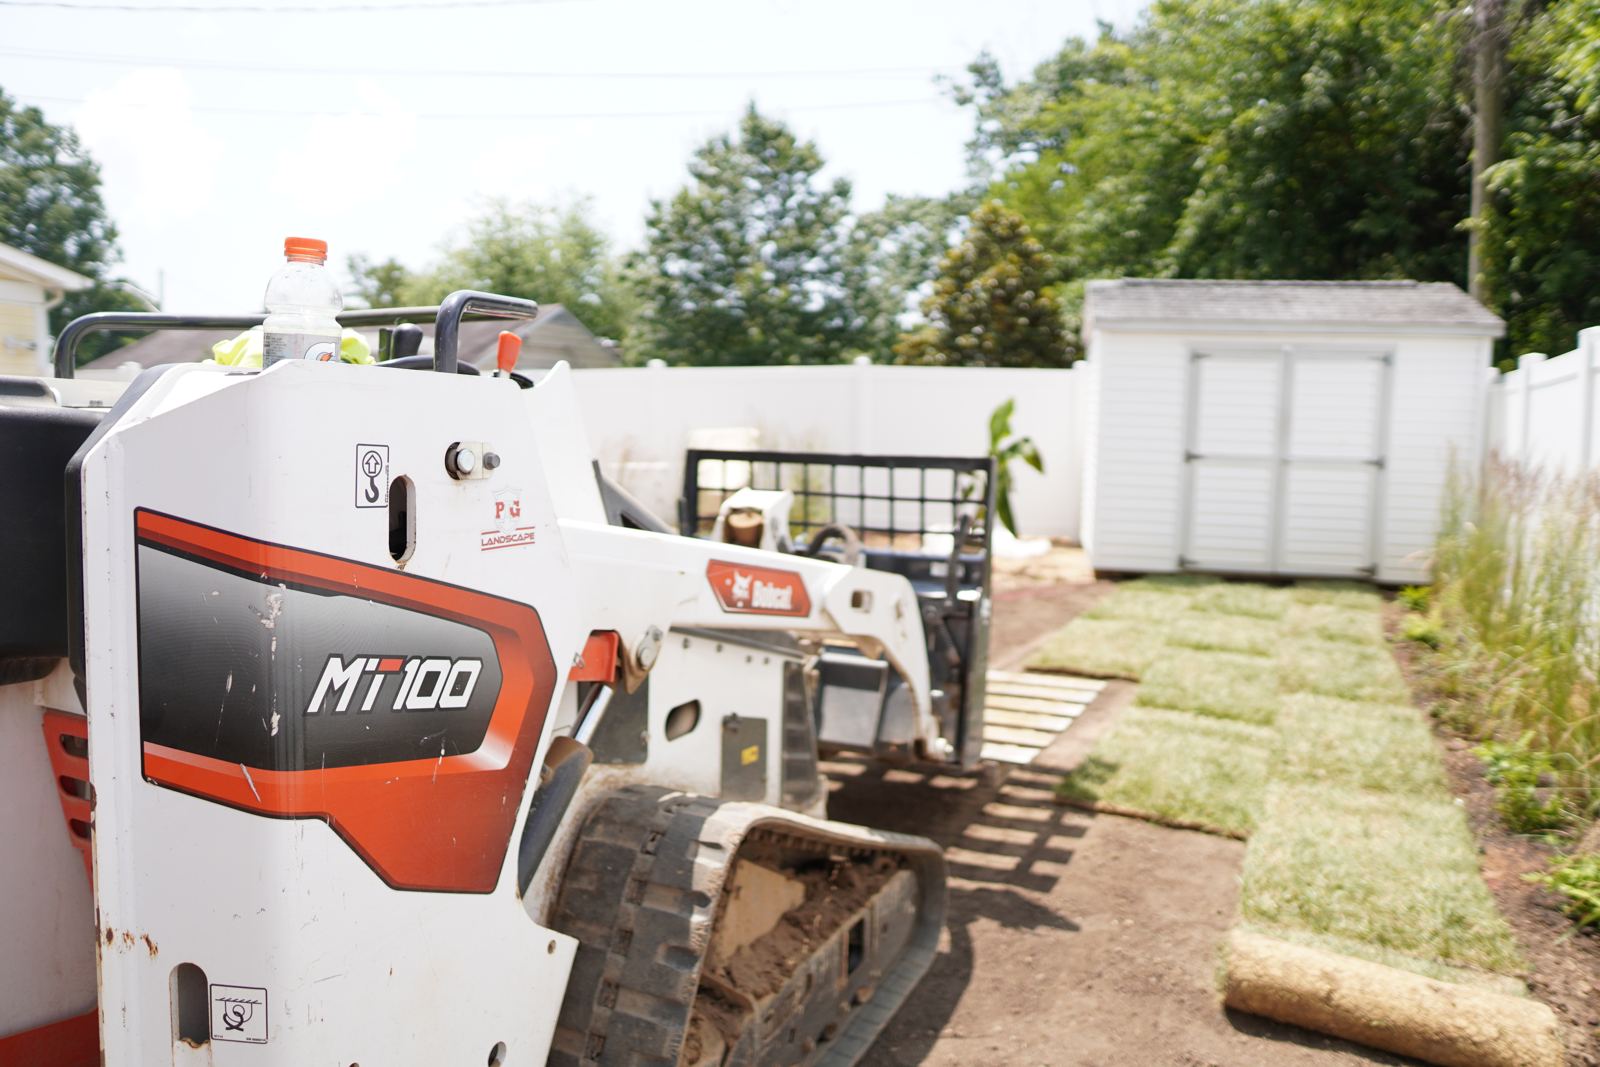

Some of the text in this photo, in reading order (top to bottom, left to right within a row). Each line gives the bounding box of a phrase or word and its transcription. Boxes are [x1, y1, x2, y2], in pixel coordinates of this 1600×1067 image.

[481, 532, 535, 547] LANDSCAPE
[751, 580, 793, 610] Bobcat
[306, 656, 483, 714] MT100
